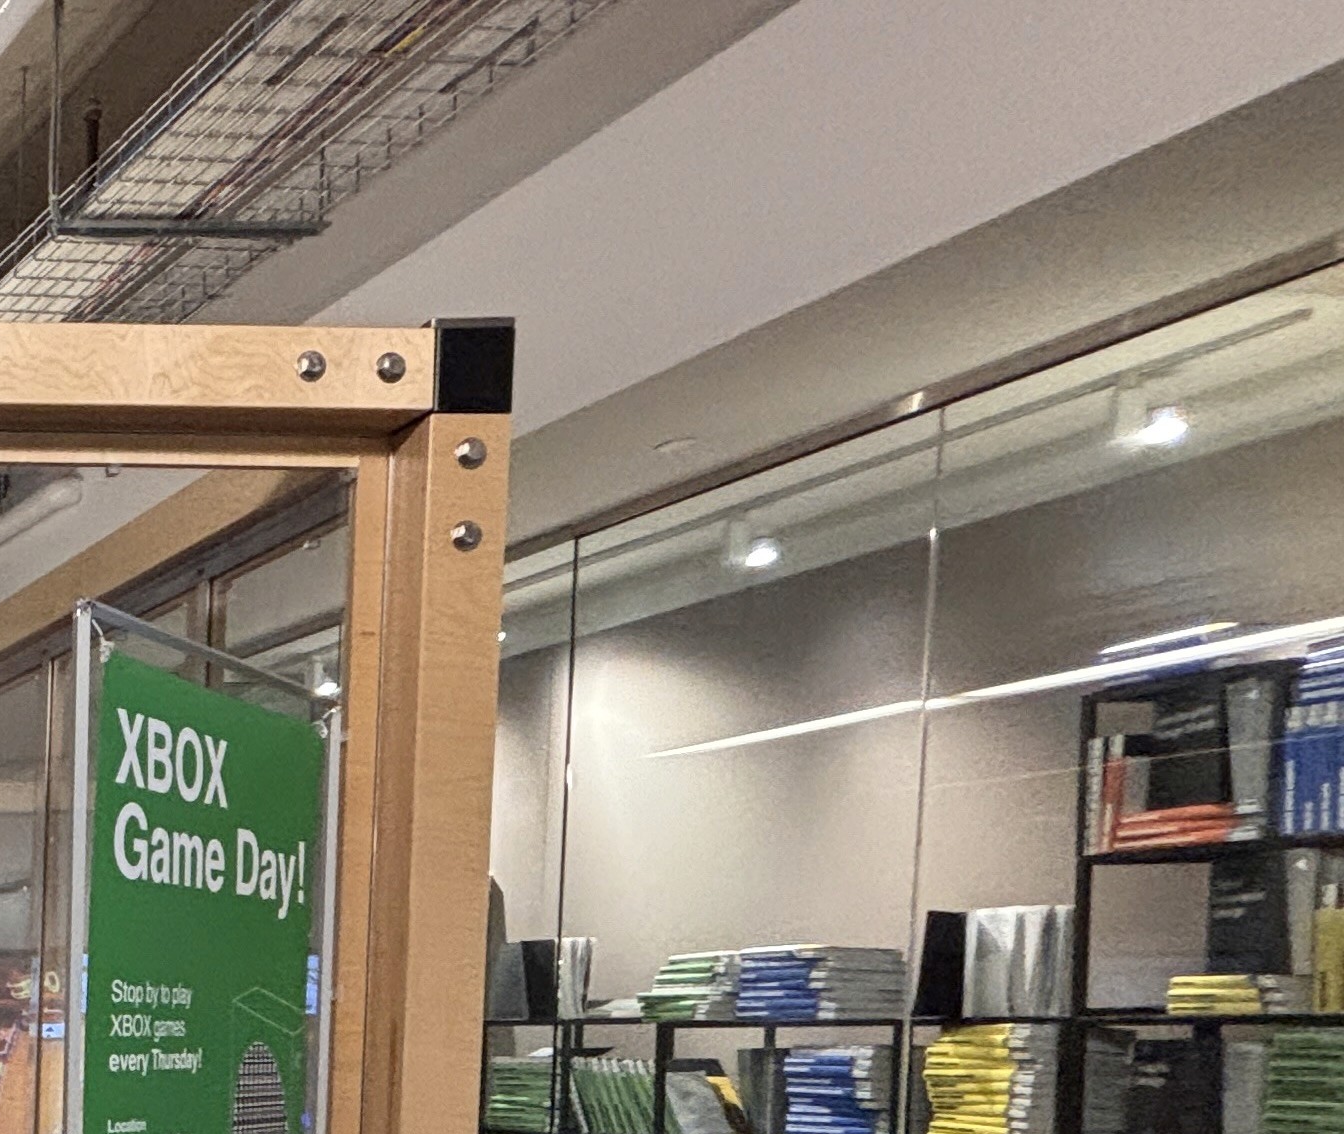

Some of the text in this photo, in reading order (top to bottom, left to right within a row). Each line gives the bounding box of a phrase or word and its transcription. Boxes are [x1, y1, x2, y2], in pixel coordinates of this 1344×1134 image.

[115, 707, 228, 809] XBOX
[113, 801, 305, 920] Game Day!
[111, 979, 192, 1009] Stop by to play
[109, 1014, 186, 1042] XBOX games
[109, 1047, 202, 1076] every Thursday!
